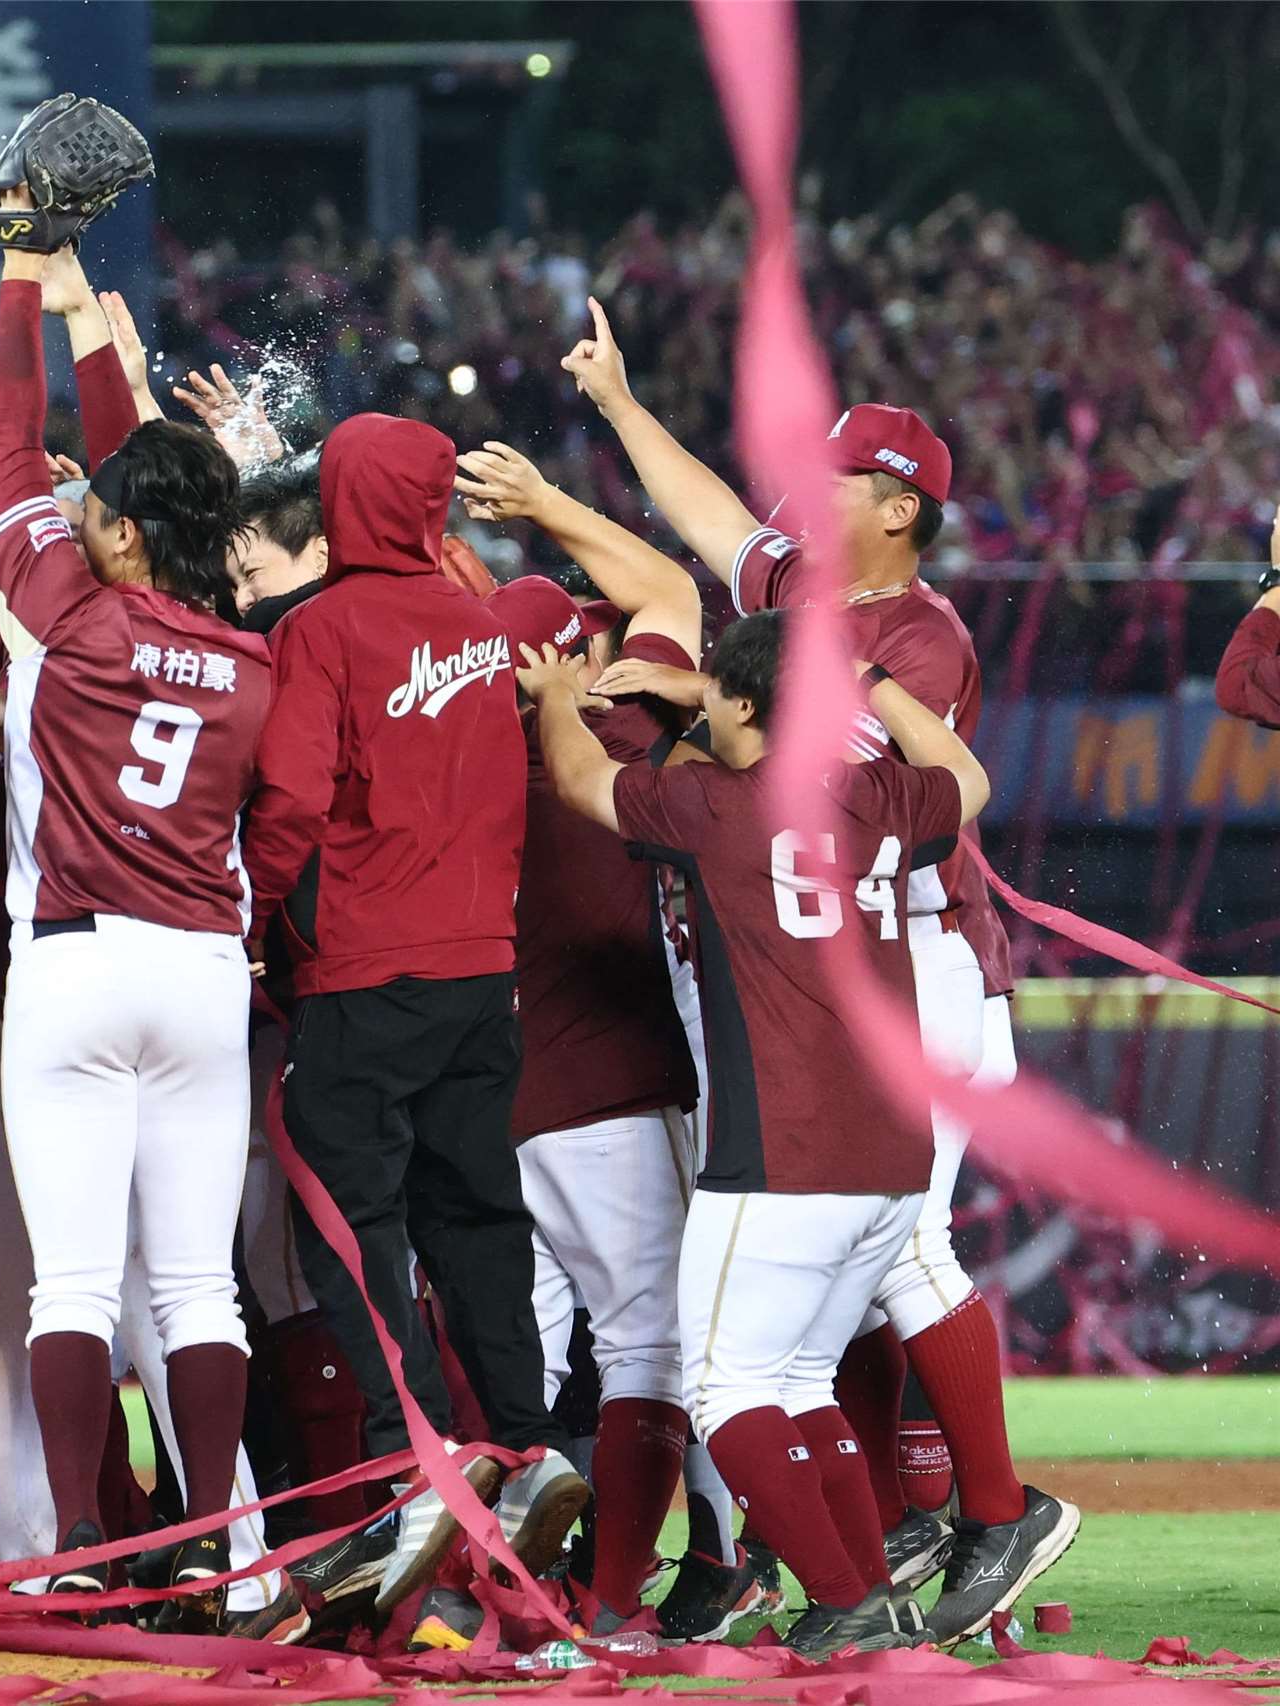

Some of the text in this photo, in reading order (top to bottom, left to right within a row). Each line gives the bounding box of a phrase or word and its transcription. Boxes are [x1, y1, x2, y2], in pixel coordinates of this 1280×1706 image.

[386, 633, 511, 719] Monkeys
[117, 700, 204, 810] 9
[771, 828, 901, 940] 64
